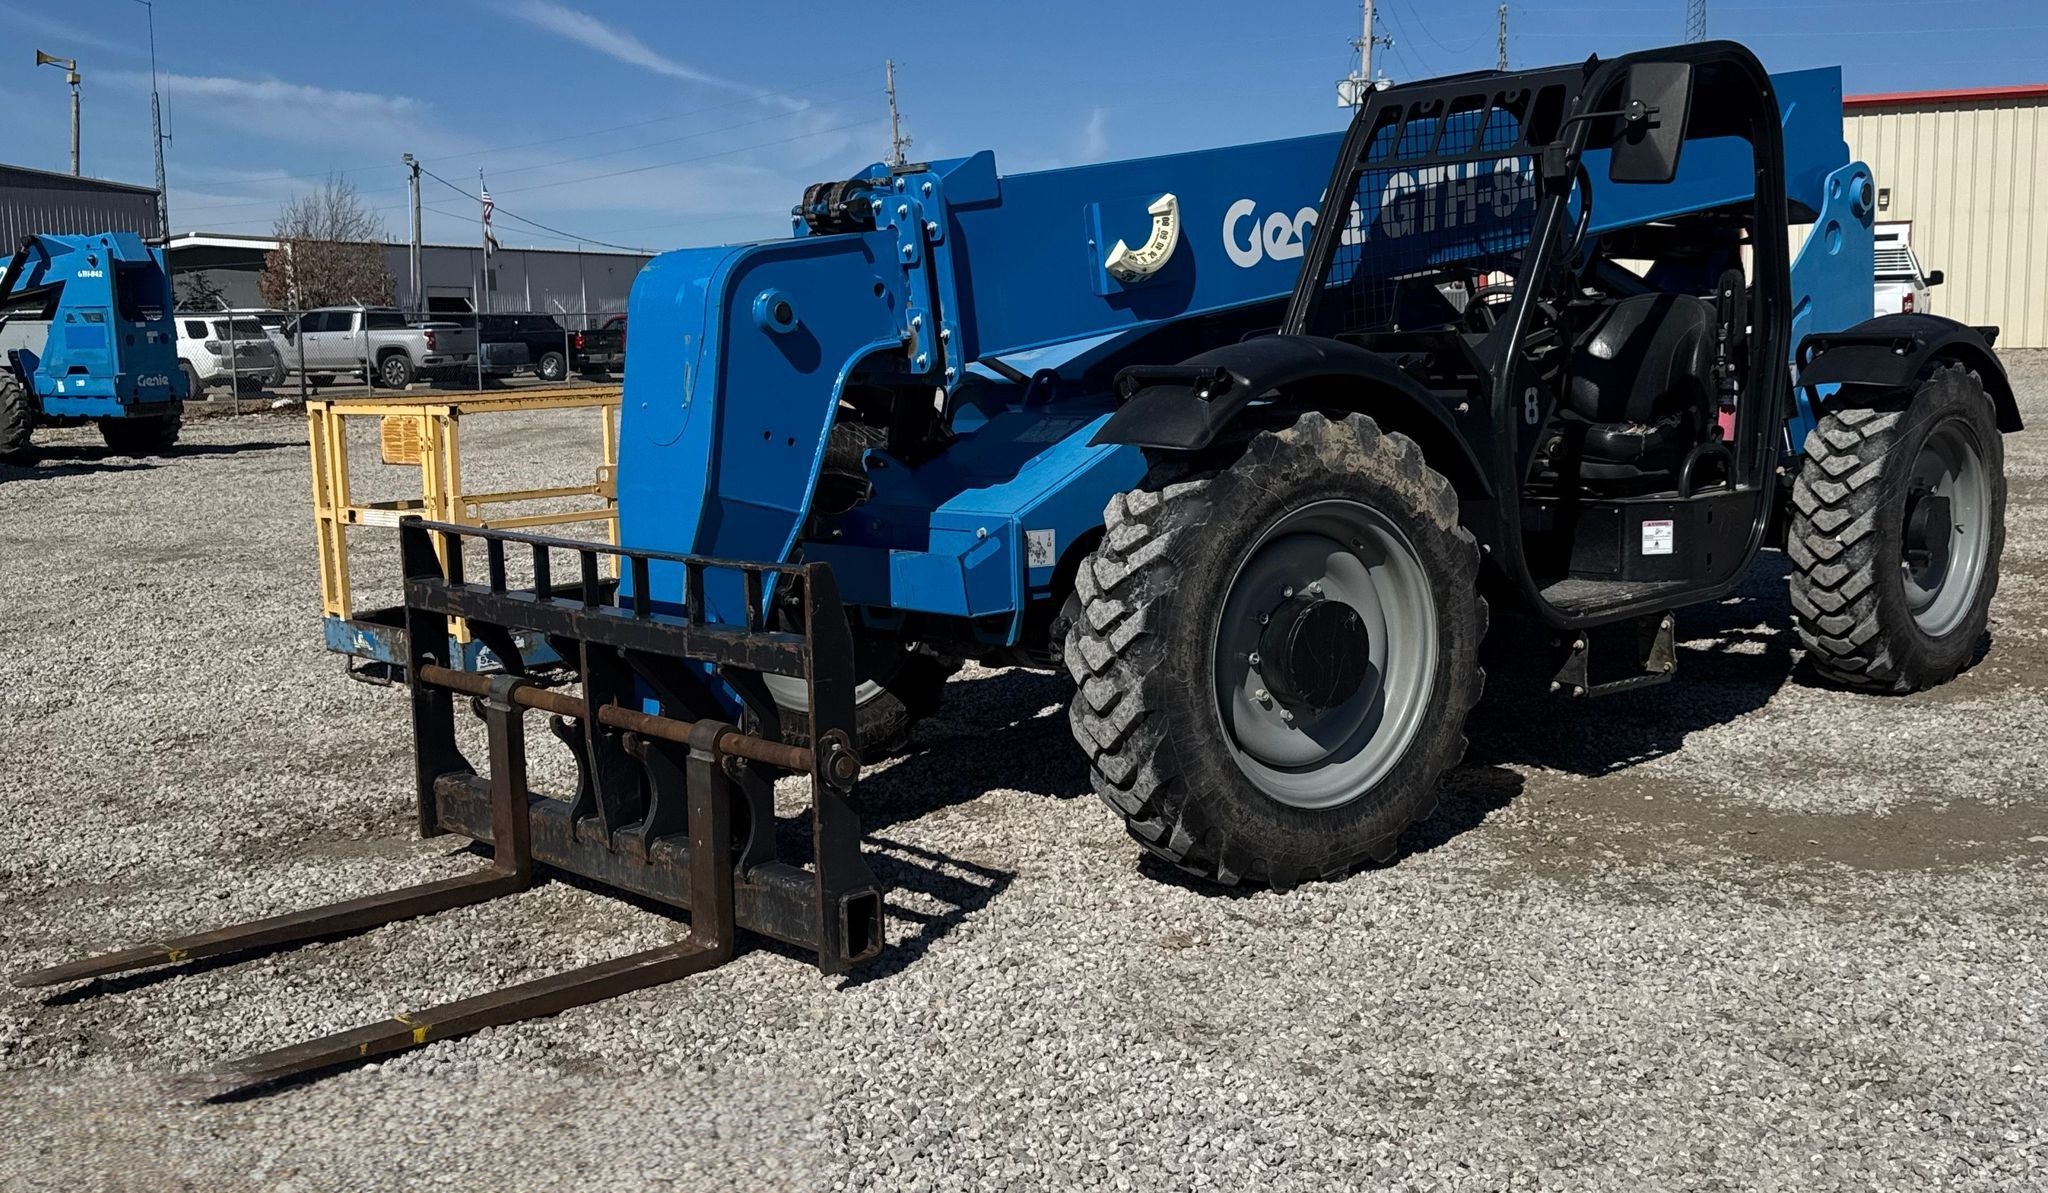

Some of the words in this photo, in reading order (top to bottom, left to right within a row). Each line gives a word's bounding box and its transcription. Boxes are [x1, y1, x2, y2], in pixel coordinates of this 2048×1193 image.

[1223, 188, 1367, 267] Gene
[137, 373, 169, 387] Genie
[1525, 387, 1539, 425] 8
